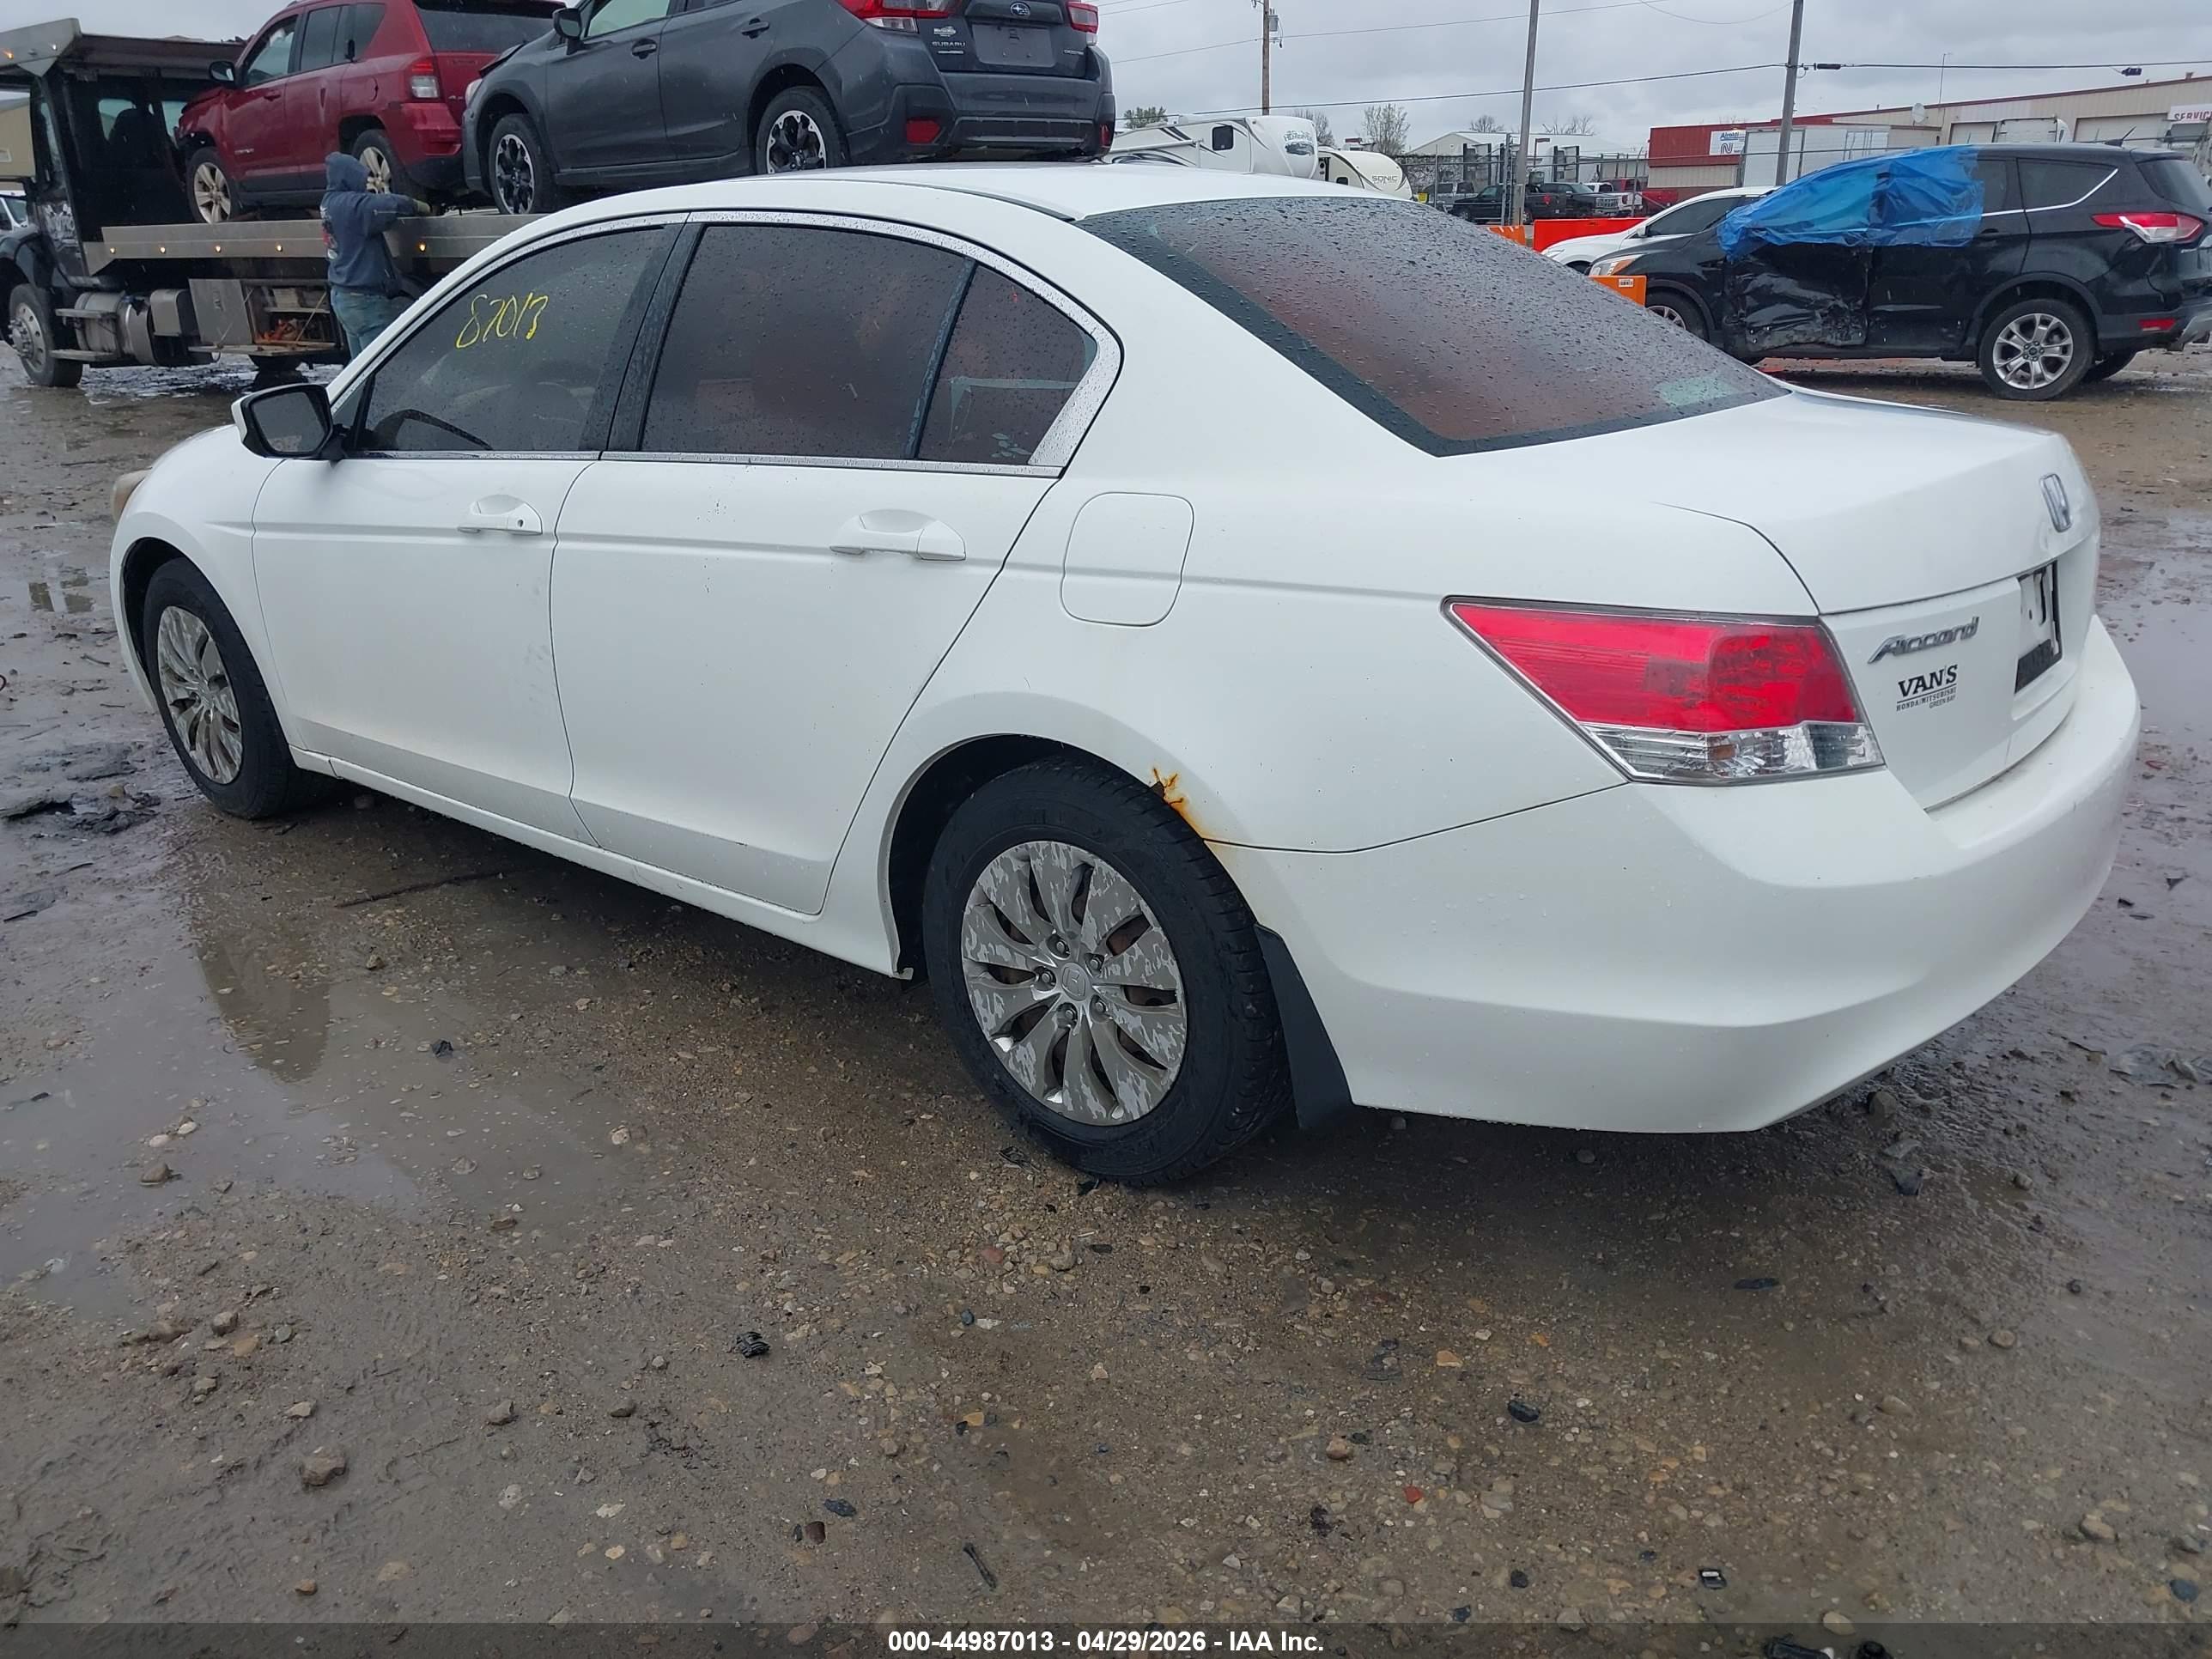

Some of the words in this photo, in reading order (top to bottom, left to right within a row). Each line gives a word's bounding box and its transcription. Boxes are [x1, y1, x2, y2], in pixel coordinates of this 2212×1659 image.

[2173, 111, 2212, 120] SERVIC
[455, 292, 550, 349] 87013
[1867, 616, 1980, 665] Accord
